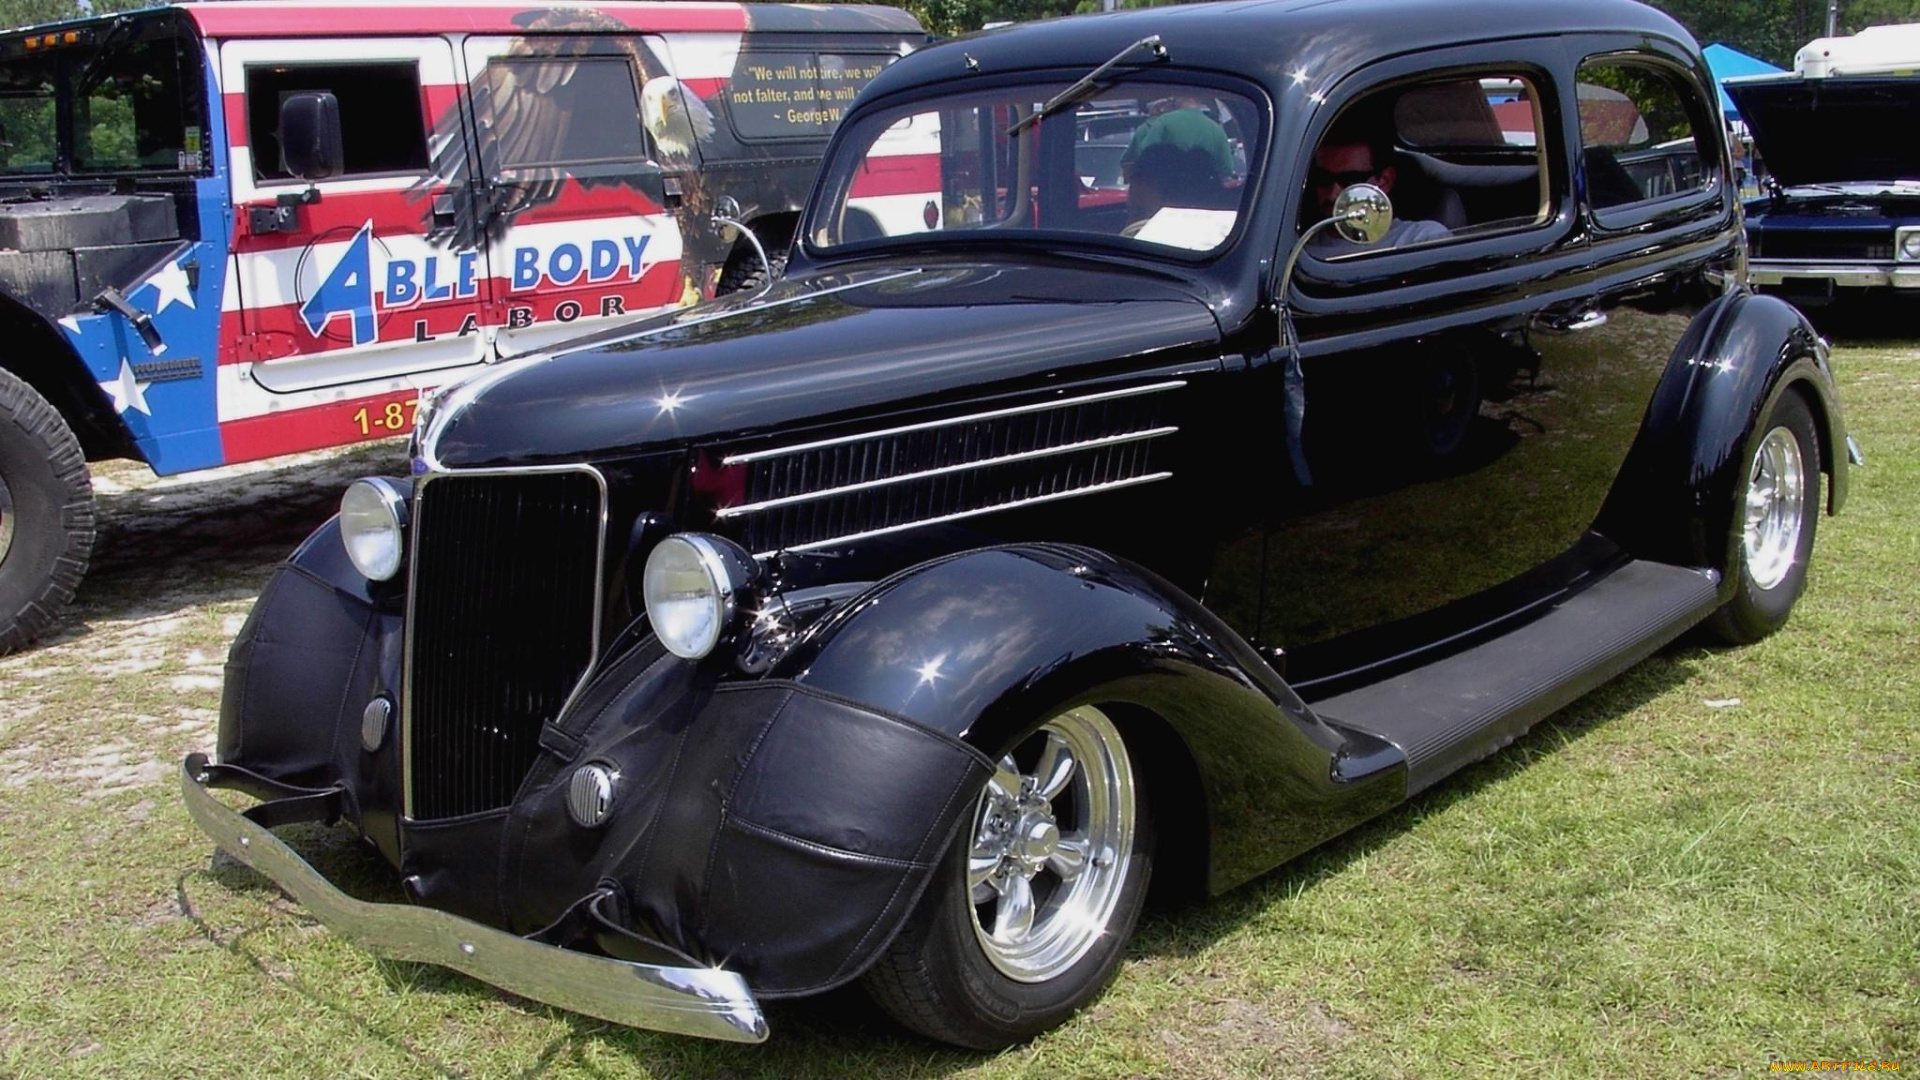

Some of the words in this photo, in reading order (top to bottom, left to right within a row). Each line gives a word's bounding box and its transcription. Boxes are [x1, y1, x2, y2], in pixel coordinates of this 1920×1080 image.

[749, 66, 773, 80] "We
[775, 66, 797, 80] will
[800, 66, 818, 79] not
[820, 66, 843, 80] tire,
[844, 68, 861, 78] we
[733, 90, 753, 103] not
[756, 88, 791, 103] falter,
[793, 87, 814, 100] and
[835, 86, 854, 99] will
[787, 108, 829, 125] George
[300, 219, 479, 345] ABLE
[512, 234, 652, 291] BODY
[414, 296, 625, 344] LABOR
